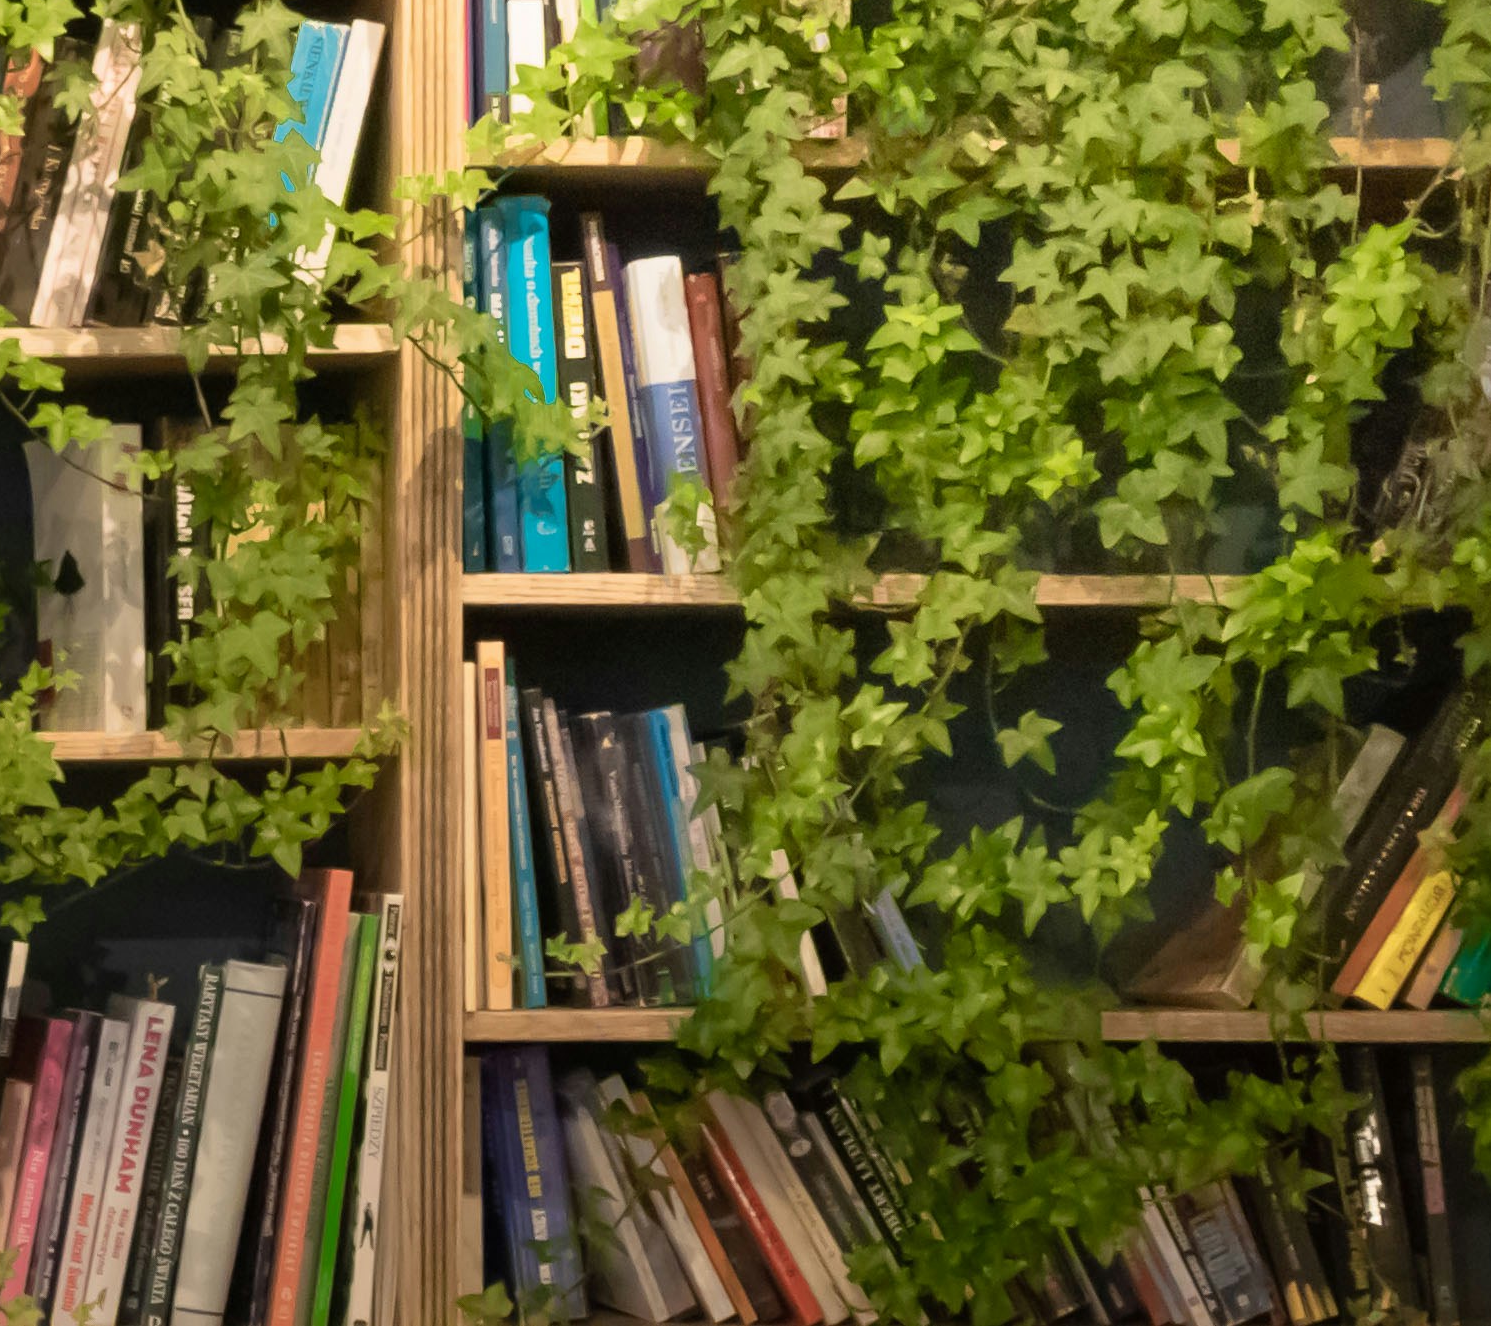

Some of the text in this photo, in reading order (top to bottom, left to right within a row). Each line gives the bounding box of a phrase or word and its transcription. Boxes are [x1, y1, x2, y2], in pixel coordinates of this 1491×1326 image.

[194, 971, 222, 1041] RARYTASY
[109, 1014, 168, 1196] LENA DUNHAM
[177, 1039, 209, 1126] WEGETARIAN
[173, 1135, 191, 1160] 100
[362, 1085, 390, 1160] SZPIEDZY
[15, 1148, 47, 1220] Nie jestem
[167, 1159, 188, 1190] DAŃ
[156, 1200, 179, 1256] CAŁEGO
[146, 1254, 171, 1306] ŚWIATA
